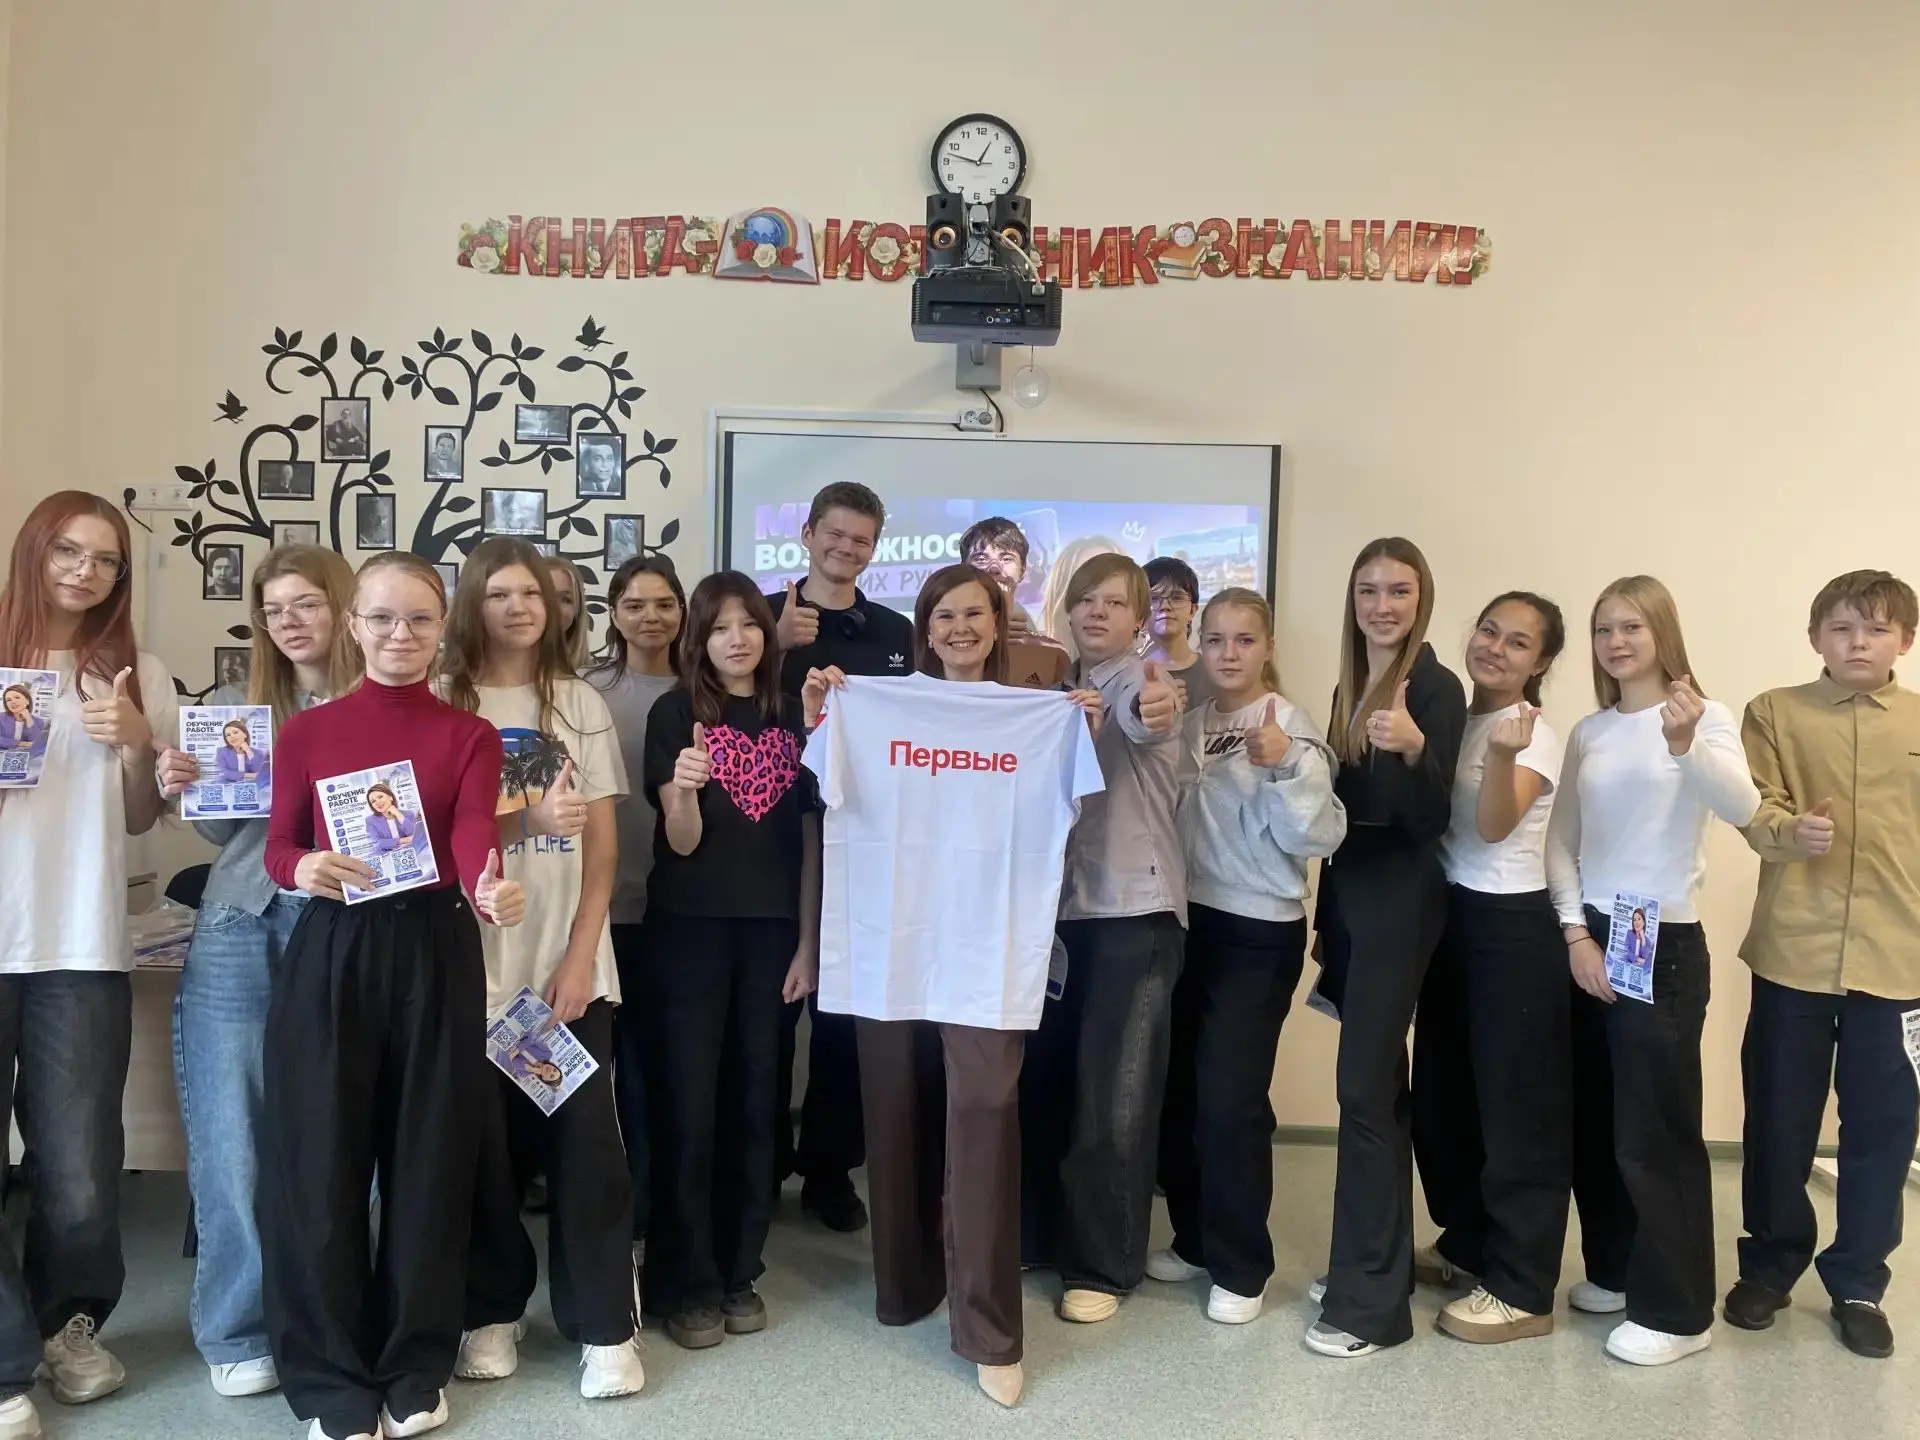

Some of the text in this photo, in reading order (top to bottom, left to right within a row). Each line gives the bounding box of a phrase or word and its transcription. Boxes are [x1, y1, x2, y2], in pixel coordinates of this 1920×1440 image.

[960, 131, 971, 139] 11
[975, 127, 988, 136] 12
[994, 132, 999, 140] 1
[948, 142, 960, 151] 10
[1004, 146, 1012, 154] 2
[942, 157, 950, 166] 9
[1008, 161, 1016, 170] 3
[947, 173, 954, 181] 8
[1001, 177, 1009, 185] 4
[957, 186, 965, 194] 7
[989, 188, 997, 196] 5
[973, 192, 980, 200] 6
[889, 740, 1018, 776] Первые
[326, 787, 366, 802] ОБУЧЕНИЕ
[328, 796, 359, 808] РАБОТЕ
[535, 836, 575, 855] LIFE
